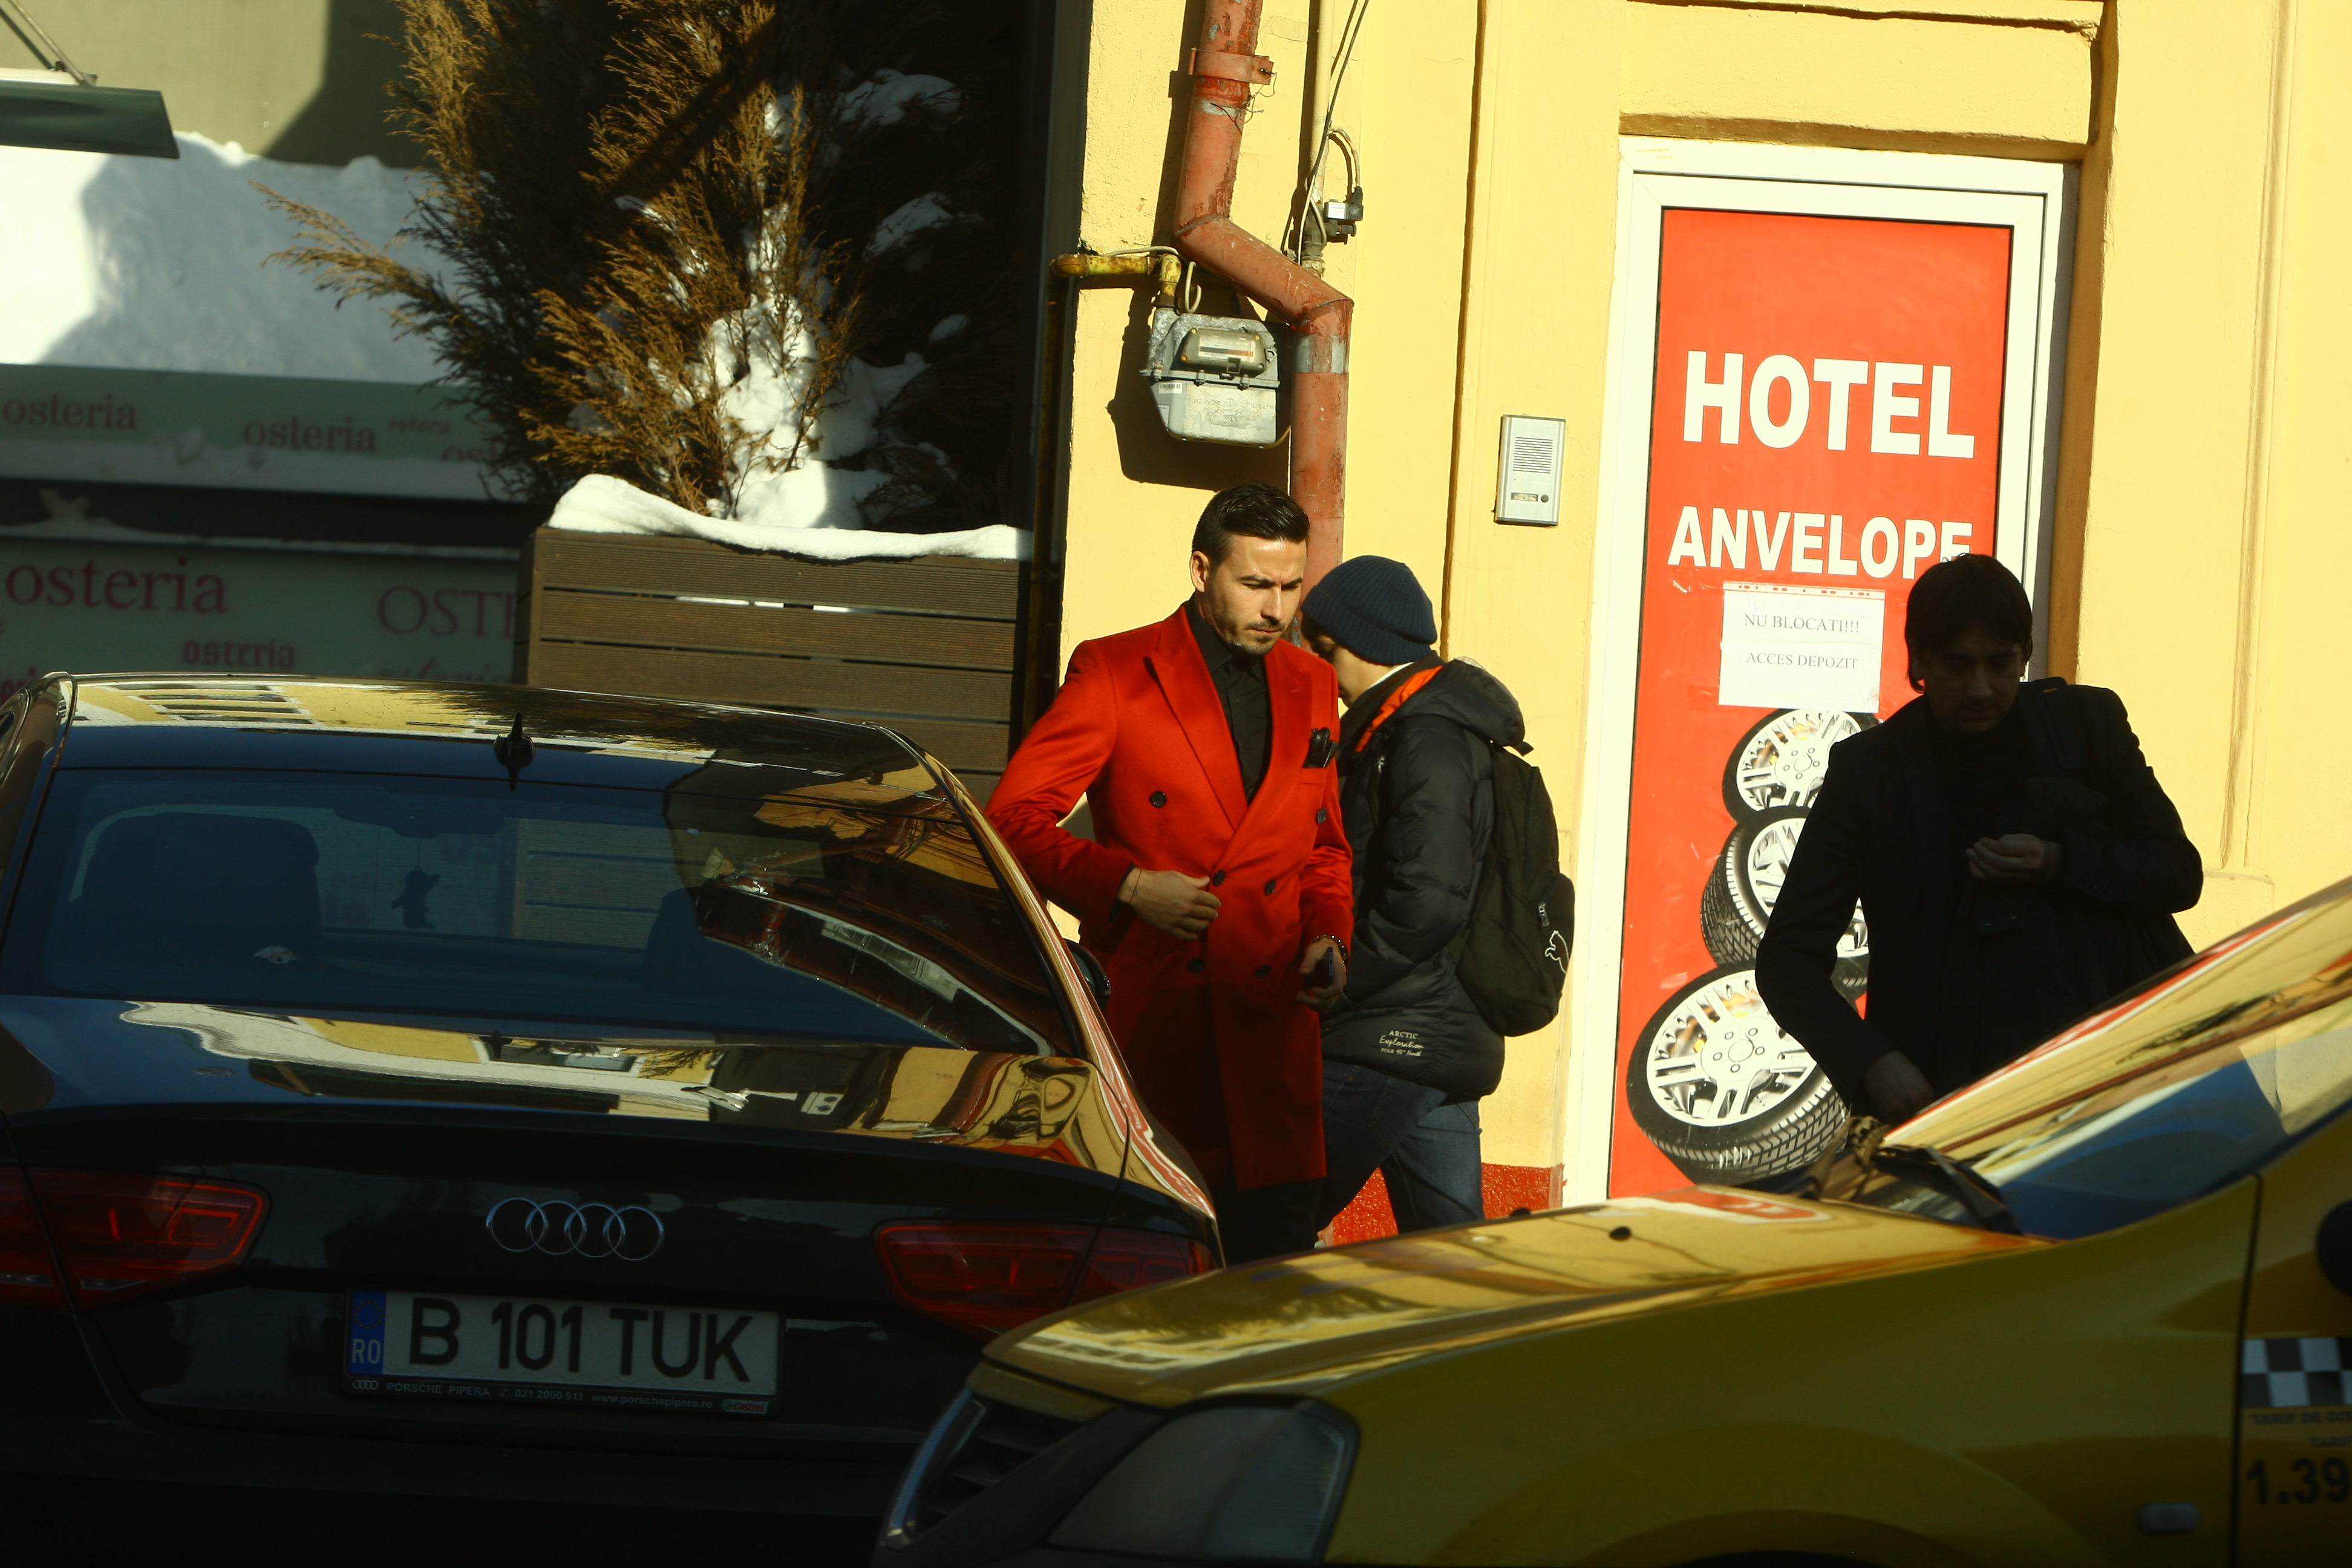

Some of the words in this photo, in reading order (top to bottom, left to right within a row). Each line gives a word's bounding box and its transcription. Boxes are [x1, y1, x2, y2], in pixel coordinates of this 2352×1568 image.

[3, 393, 137, 430] osteria
[1684, 350, 1975, 458] HOTEL
[244, 416, 377, 452] osteria
[1667, 506, 1973, 579] ANVELOPE
[5, 555, 229, 615] osteria
[1744, 613, 1767, 627] NU
[1772, 615, 1859, 633] BLOCATI!!!
[183, 638, 296, 670] osteria
[1746, 652, 1793, 665] ACCES
[1797, 655, 1858, 668] DEPOZIT
[1379, 1035, 1423, 1049] Exploration
[1388, 1030, 1418, 1039] ARCTIC
[351, 1338, 381, 1365] RO
[410, 1296, 461, 1366] B
[491, 1301, 583, 1373] 101
[609, 1307, 753, 1383] TUK
[387, 1382, 442, 1394] PORSCHE
[515, 1389, 534, 1399] 021
[537, 1390, 563, 1400] 2000
[566, 1392, 583, 1402] 911
[592, 1394, 713, 1410] www.porschepipera.ro
[734, 1402, 765, 1413] Castrol
